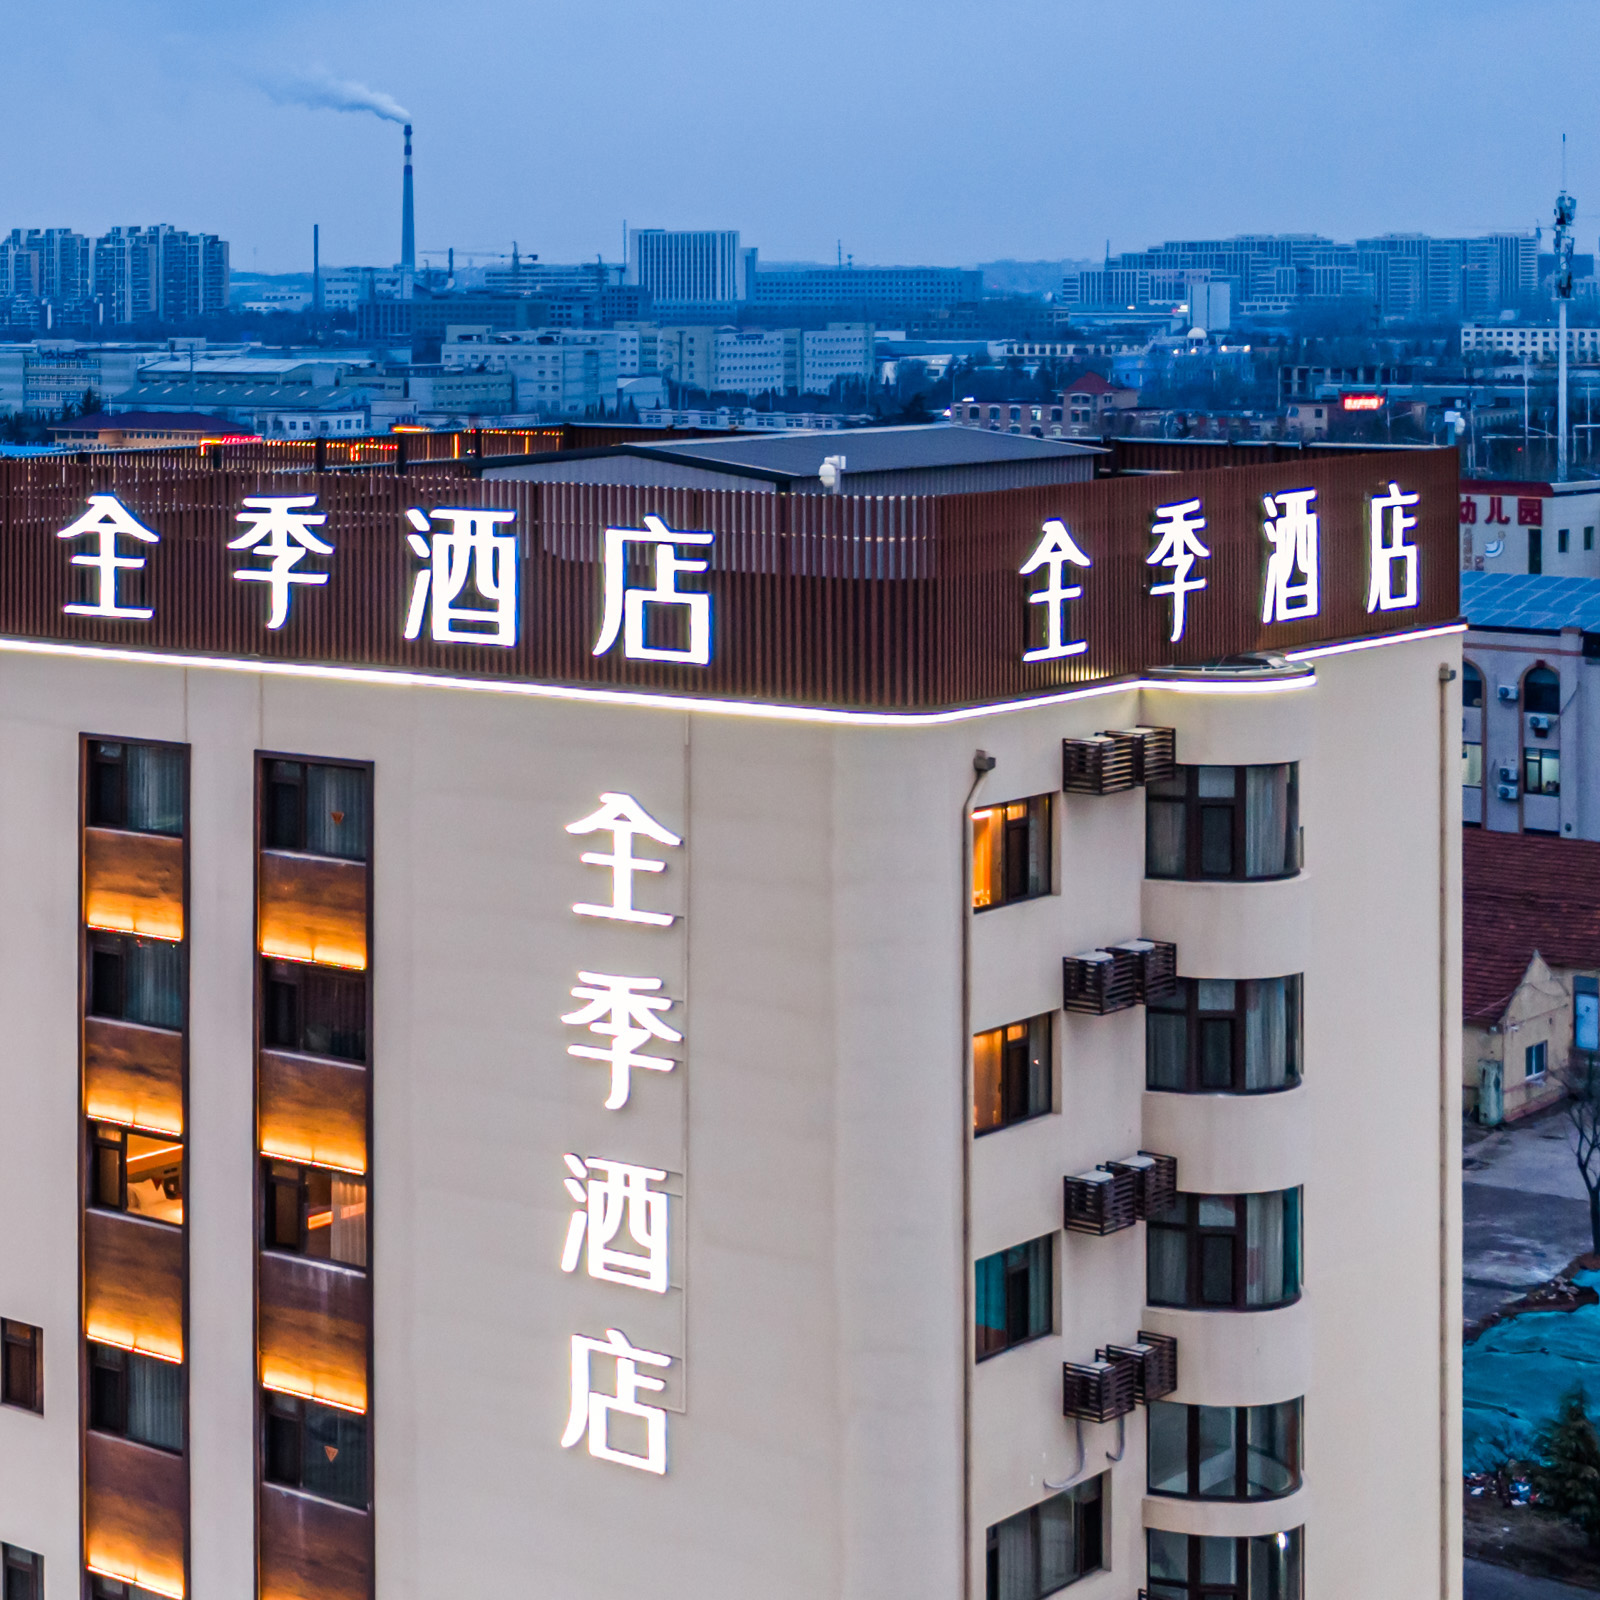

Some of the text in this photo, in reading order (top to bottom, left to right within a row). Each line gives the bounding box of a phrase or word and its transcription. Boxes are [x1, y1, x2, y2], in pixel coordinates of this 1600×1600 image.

[56, 492, 714, 666] 全季酒店
[1019, 481, 1420, 663] 全季酒店
[560, 792, 683, 1475] 全季酒店
